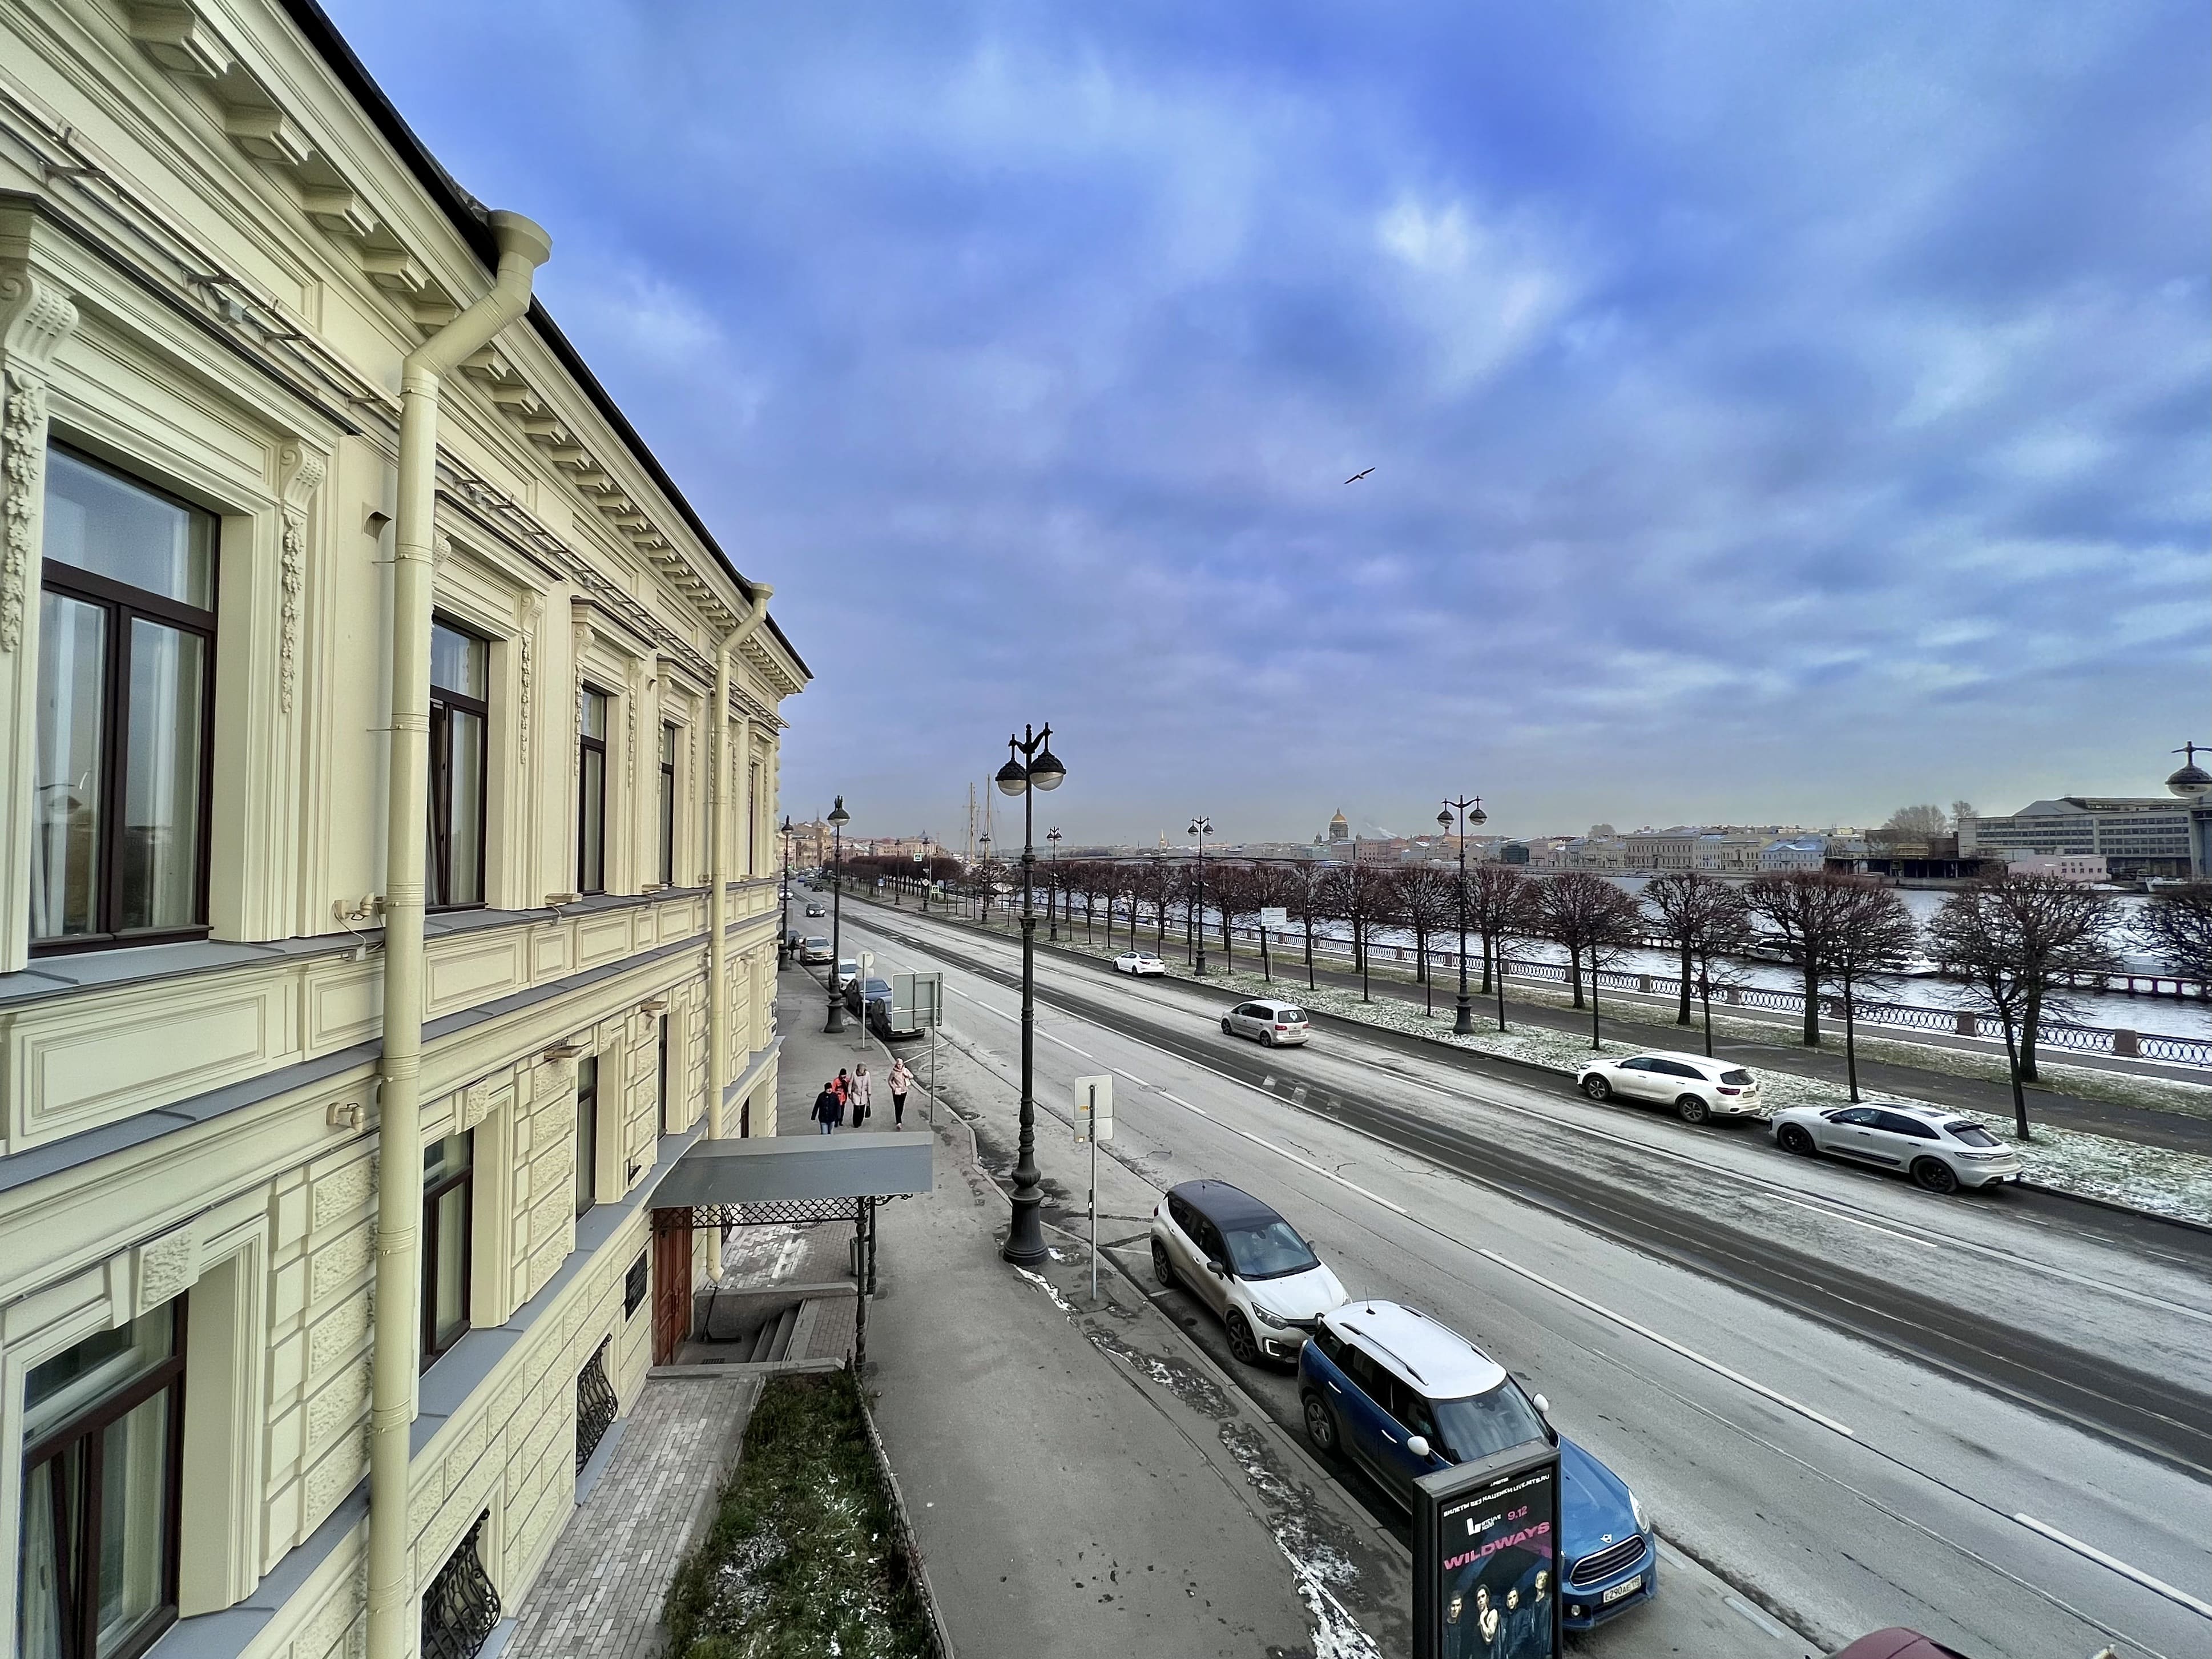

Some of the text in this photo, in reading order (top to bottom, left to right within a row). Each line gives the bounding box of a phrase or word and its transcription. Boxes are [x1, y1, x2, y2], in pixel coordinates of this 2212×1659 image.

[1443, 1502, 1469, 1517] БИЛЕТЫ
[1470, 1498, 1482, 1507] БЕЗ
[1482, 1488, 1513, 1502] НАЦЕНКИ
[1508, 1505, 1528, 1520] 9.12
[1444, 1521, 1550, 1570] WILDWAYS
